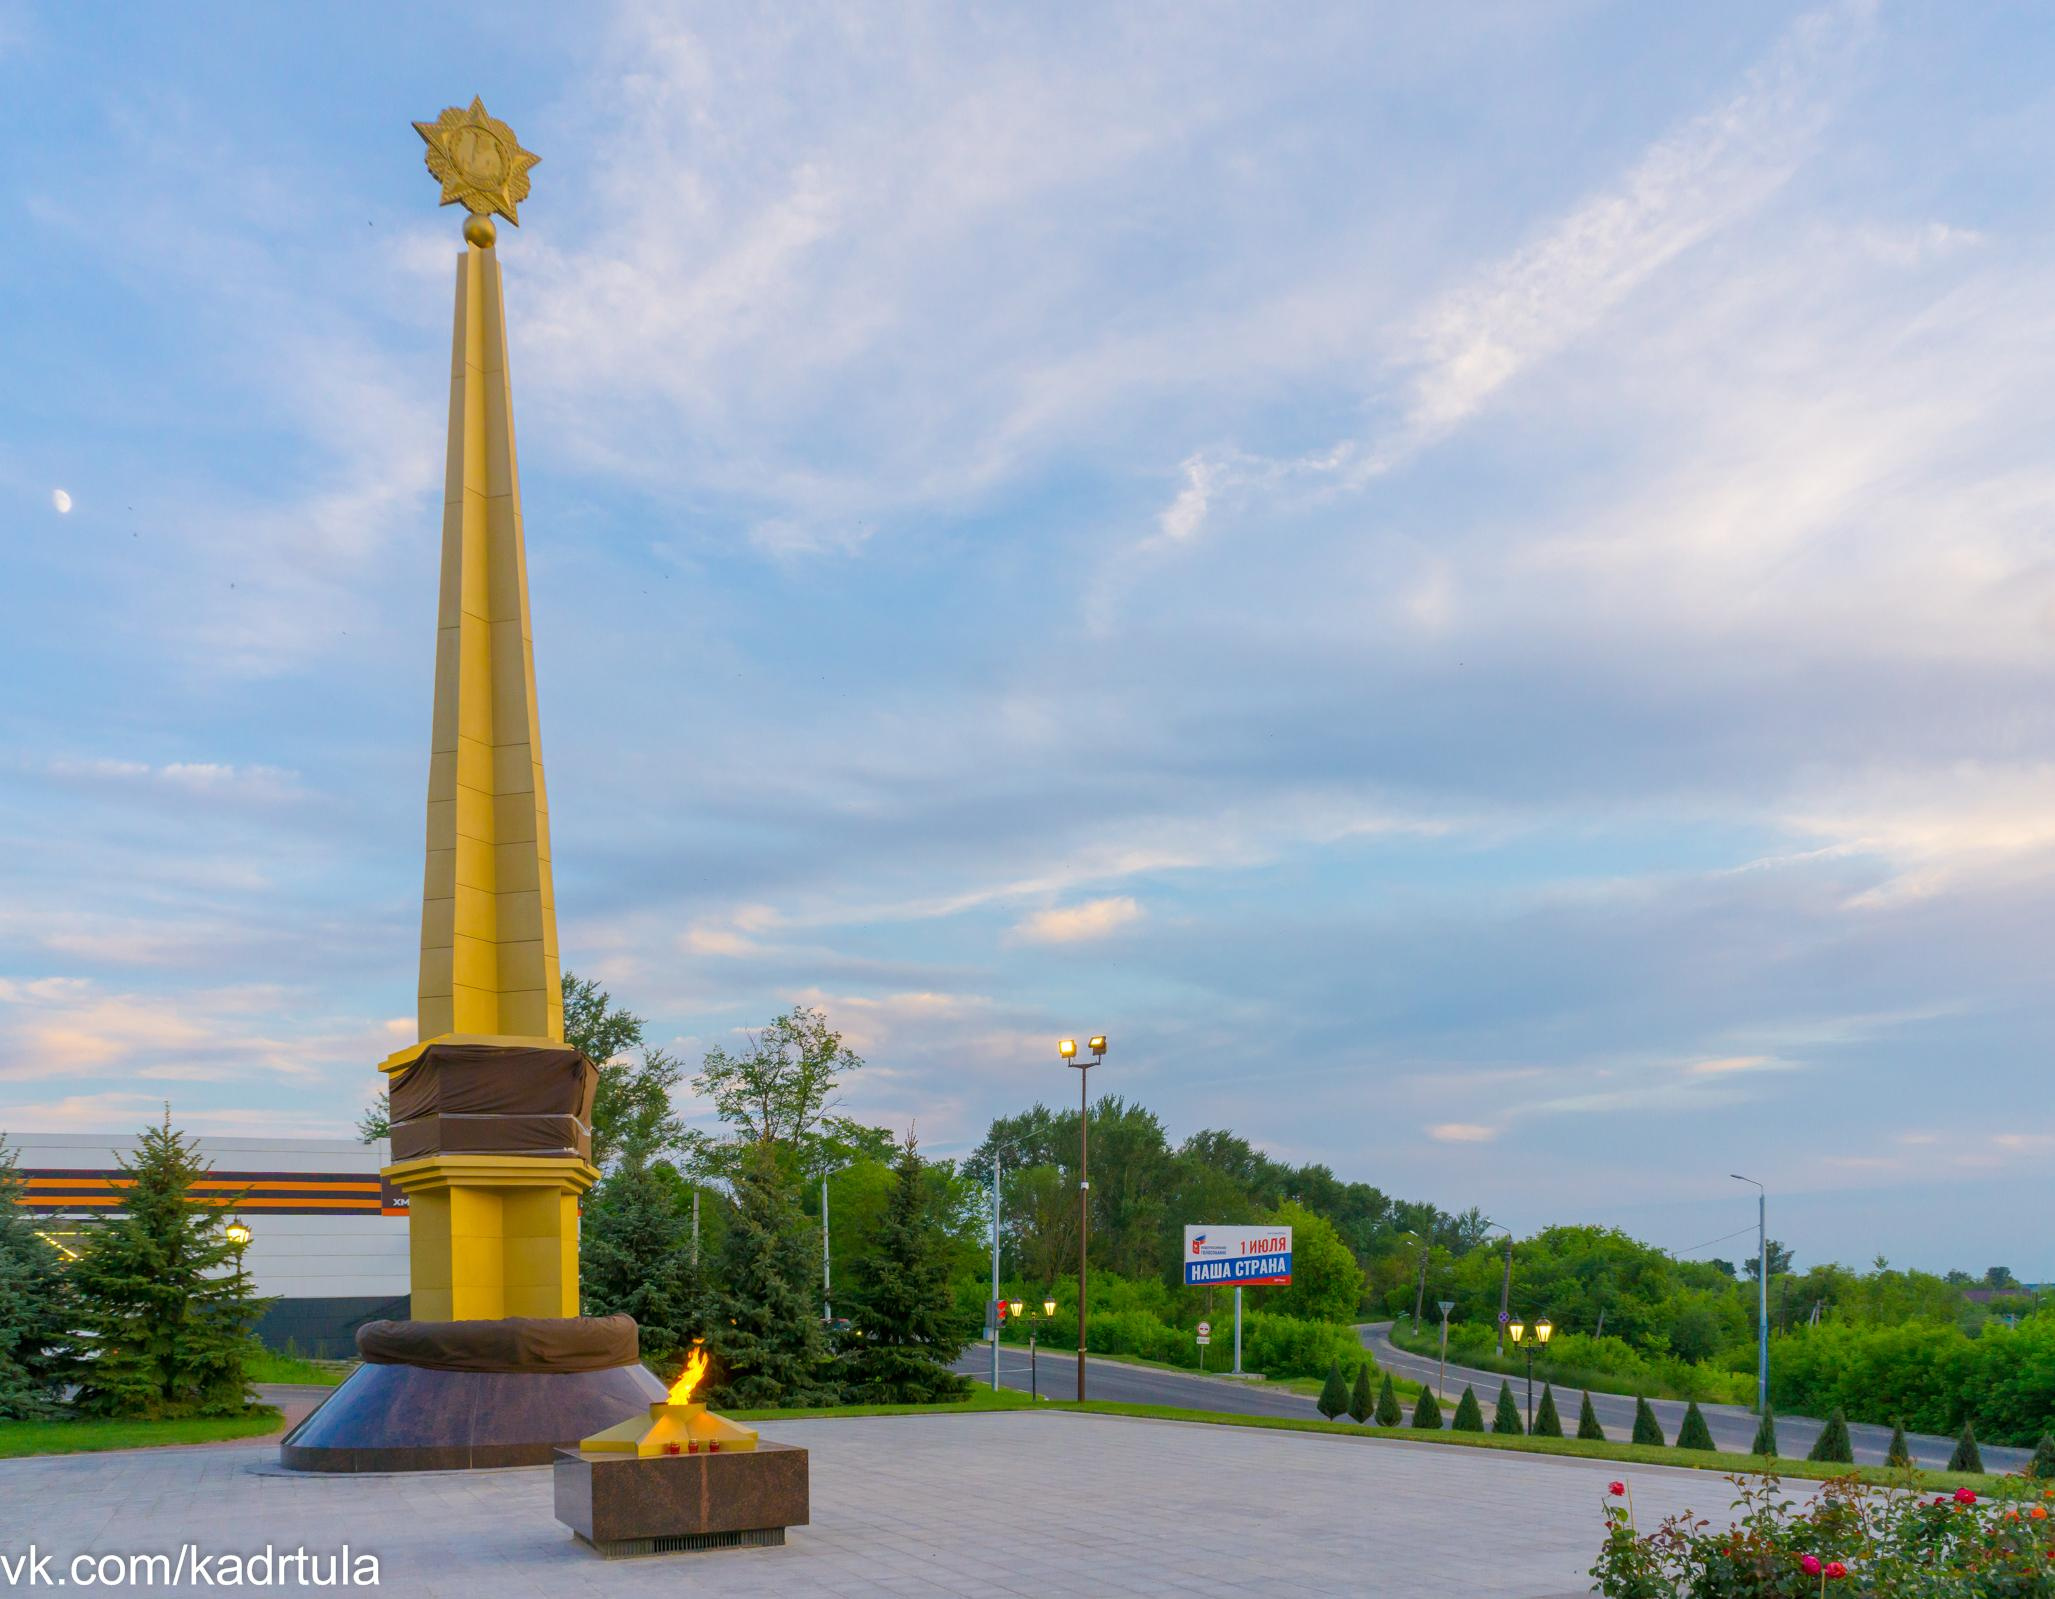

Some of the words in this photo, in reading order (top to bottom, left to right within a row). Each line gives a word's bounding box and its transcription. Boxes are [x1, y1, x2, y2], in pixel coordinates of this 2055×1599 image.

[1240, 1241, 1246, 1255] 1
[1249, 1237, 1286, 1254] ИЮЛЯ
[1191, 1262, 1231, 1281] НАША
[1235, 1257, 1286, 1277] СТРАНА
